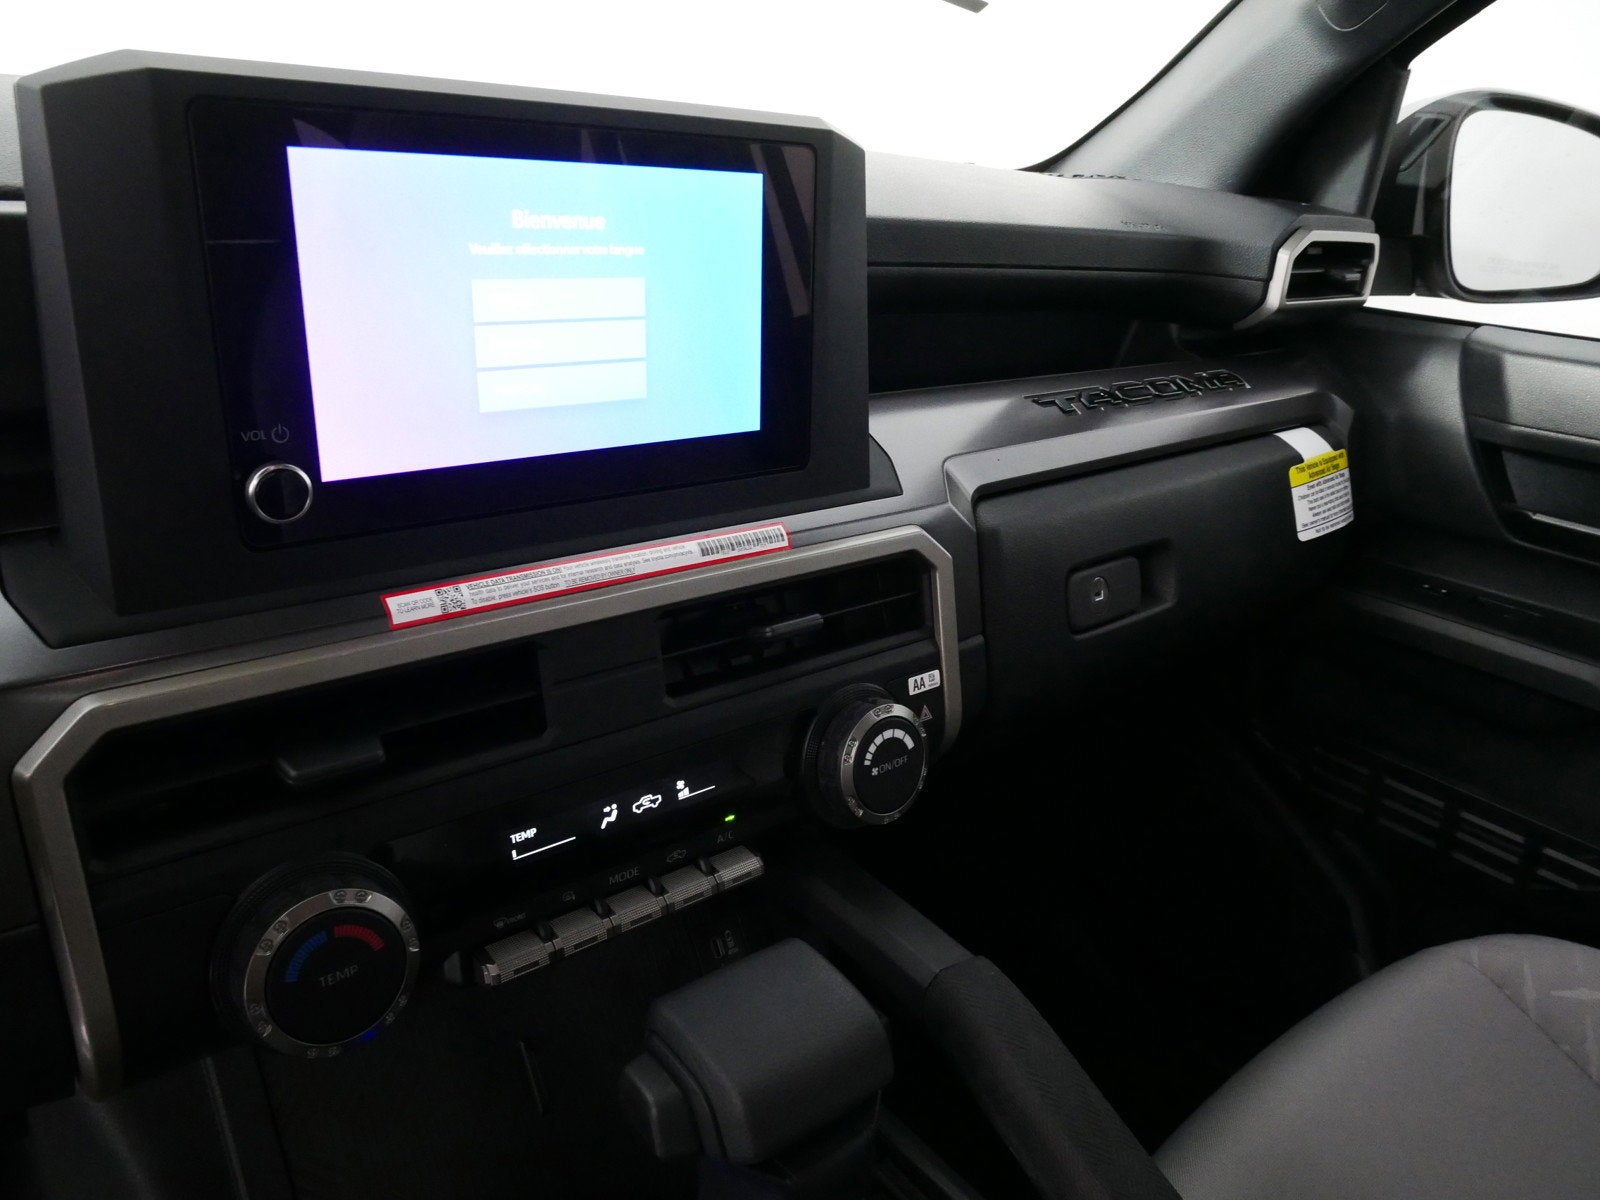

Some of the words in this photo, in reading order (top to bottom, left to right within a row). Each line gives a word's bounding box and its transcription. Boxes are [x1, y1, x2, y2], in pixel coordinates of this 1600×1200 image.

[512, 209, 606, 230] Bienvenue
[1022, 368, 1251, 416] TACOMA
[240, 430, 268, 442] VOL
[912, 677, 926, 692] AA
[879, 755, 909, 774] ON/OFF
[510, 827, 537, 844] TEMP
[609, 866, 640, 885] MODE
[318, 964, 359, 988] TEMP
